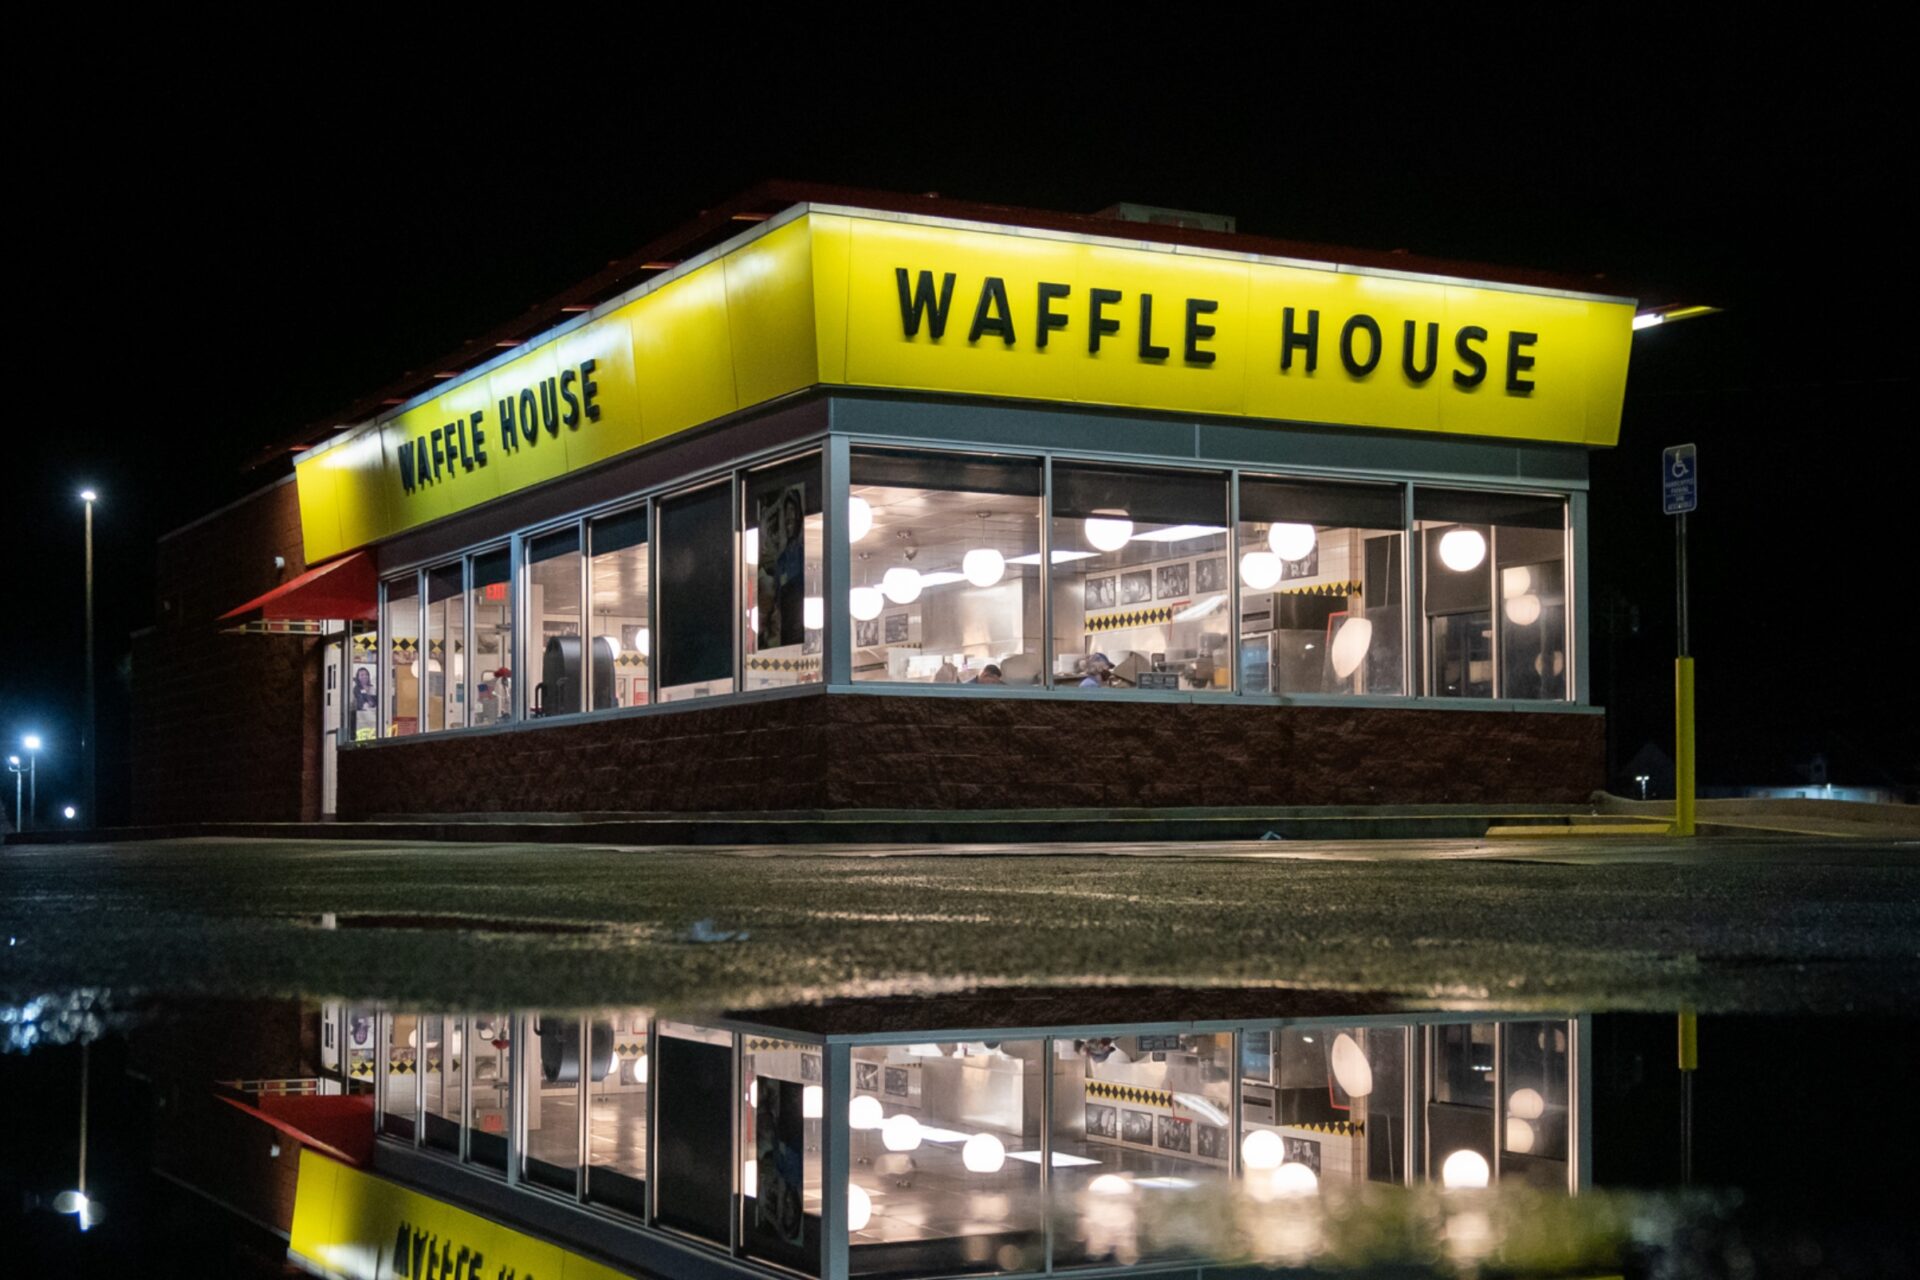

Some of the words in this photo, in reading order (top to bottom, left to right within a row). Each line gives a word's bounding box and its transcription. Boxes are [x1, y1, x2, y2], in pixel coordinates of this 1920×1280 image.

[895, 267, 1218, 369] WAFFLE
[1280, 307, 1538, 399] HOUSE
[398, 413, 487, 497] WAFFLE
[500, 359, 601, 453] HOUSE
